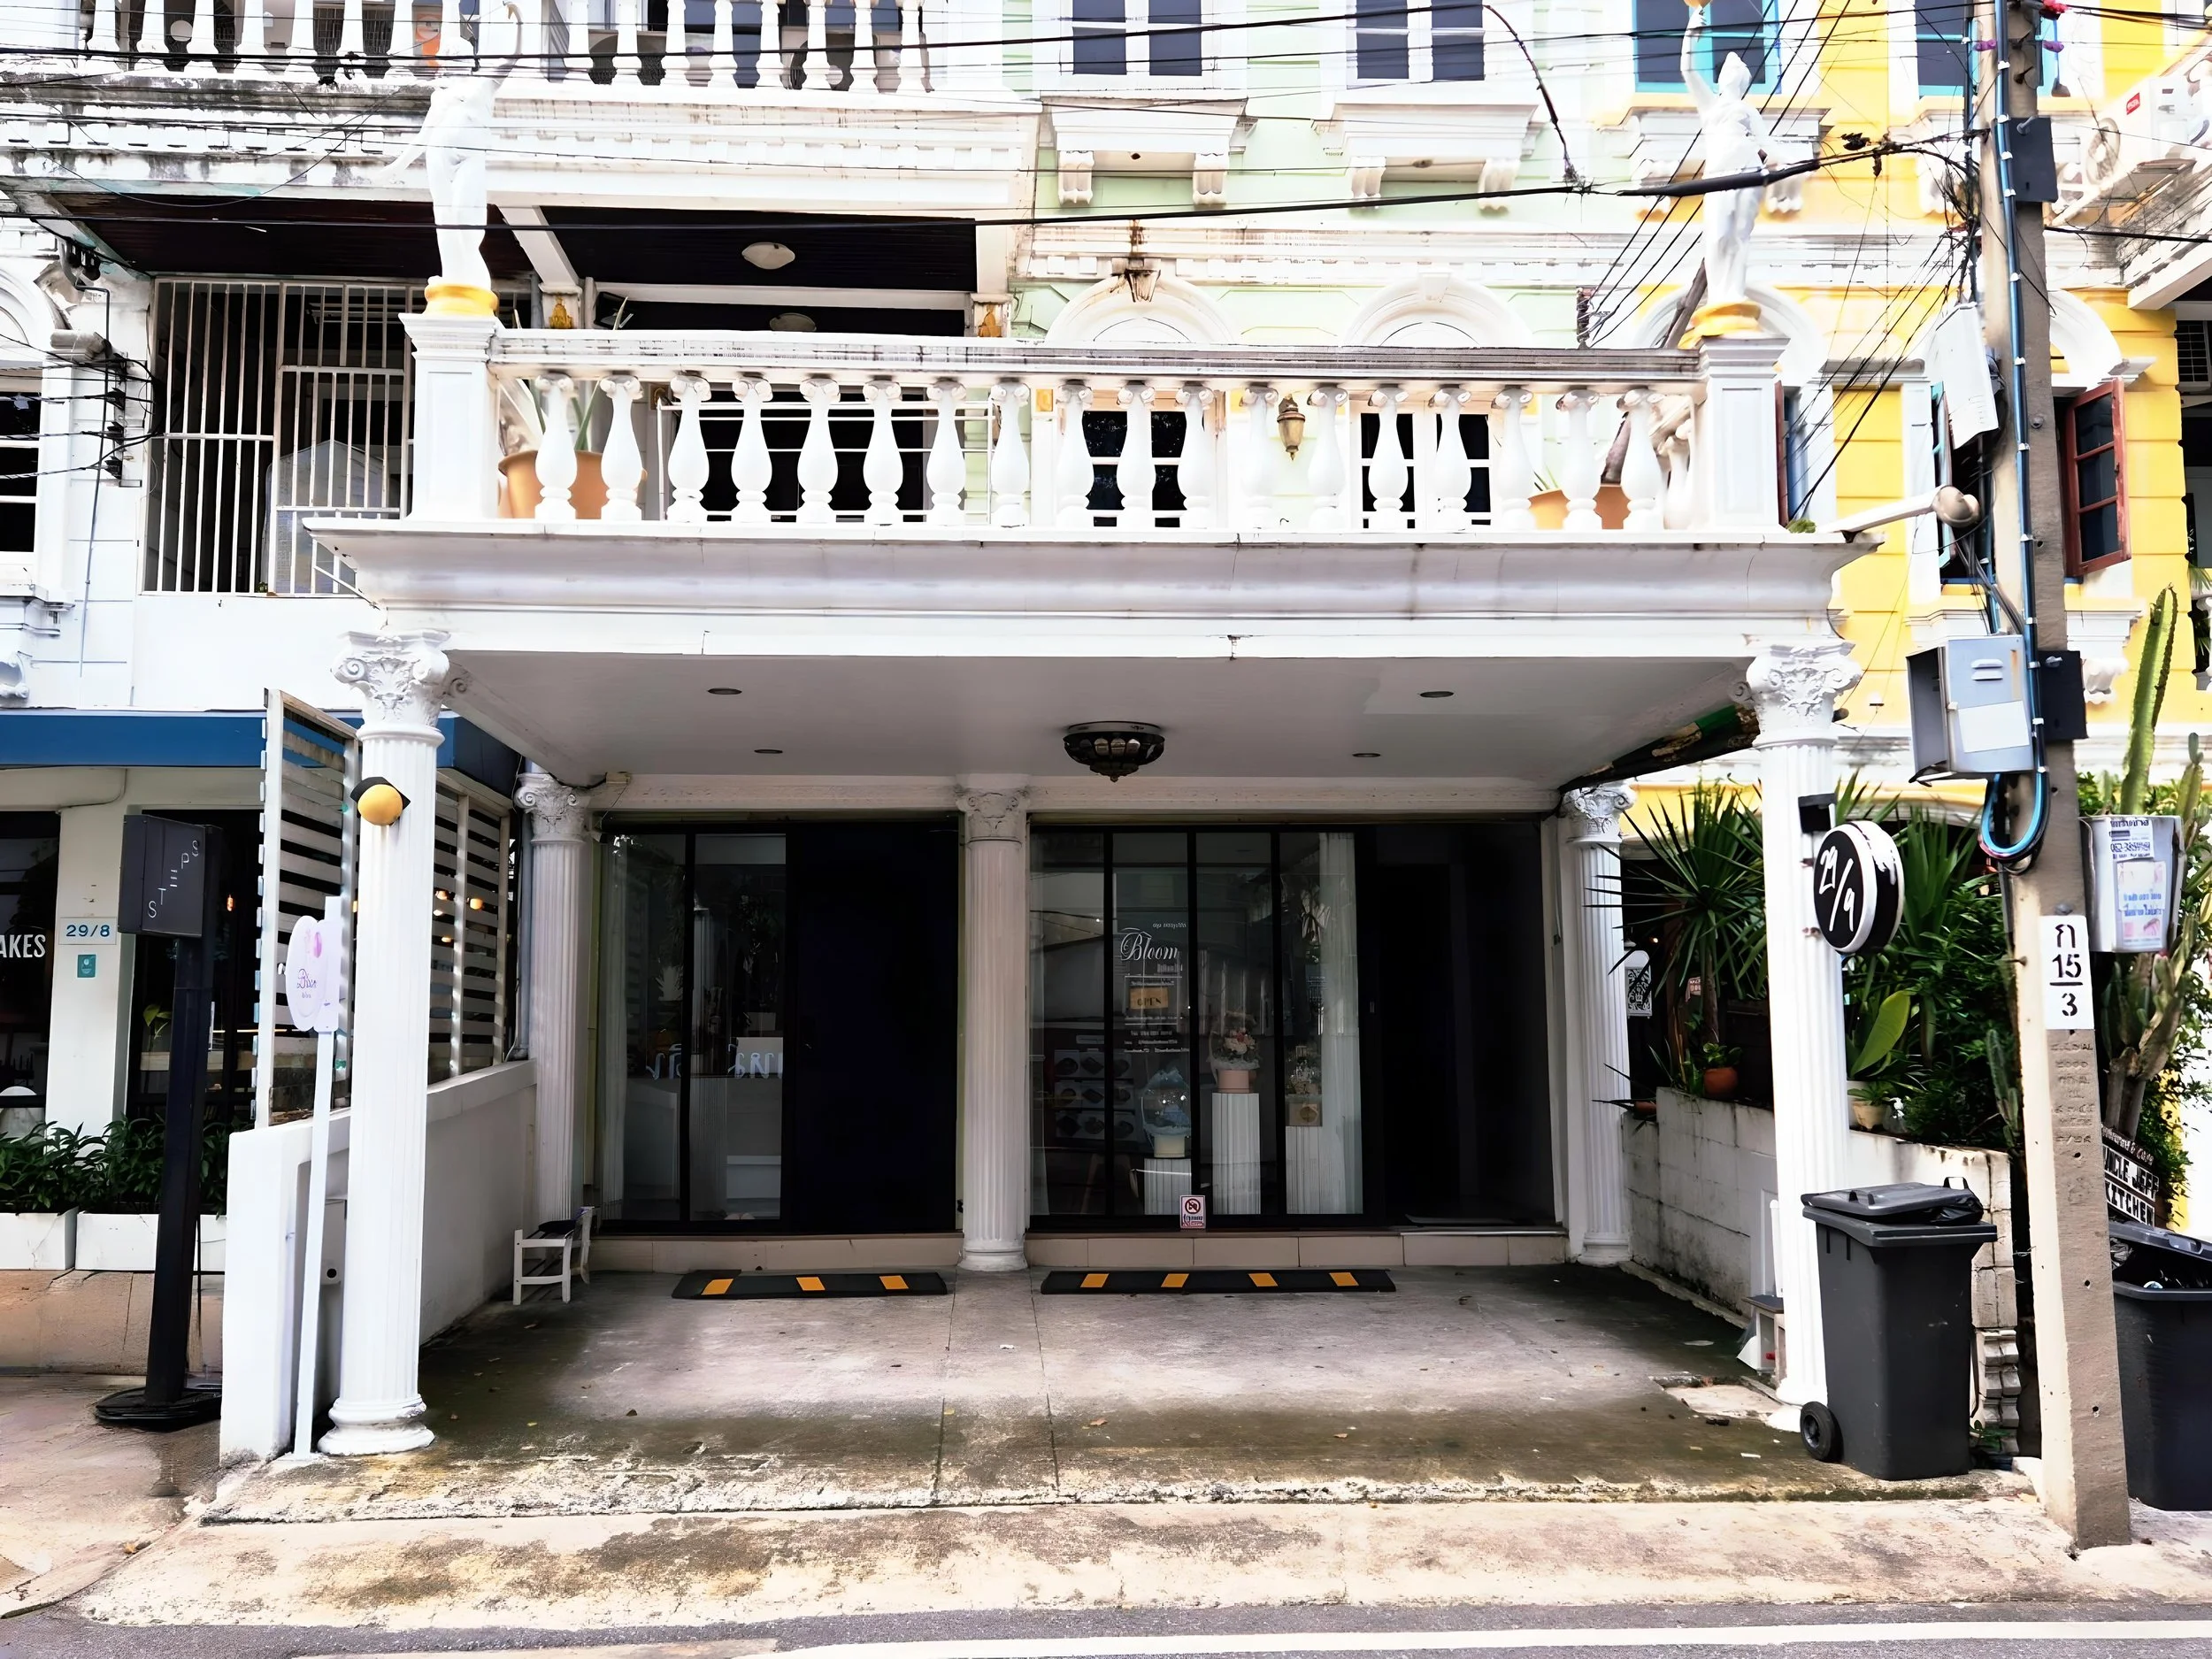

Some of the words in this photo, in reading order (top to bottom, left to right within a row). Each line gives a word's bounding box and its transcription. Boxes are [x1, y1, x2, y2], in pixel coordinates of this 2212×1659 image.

[148, 840, 199, 918] STEPS
[65, 924, 110, 938] 29/8
[1120, 927, 1179, 961] Bloom
[2052, 954, 2081, 978] 15
[2062, 993, 2078, 1016] 3
